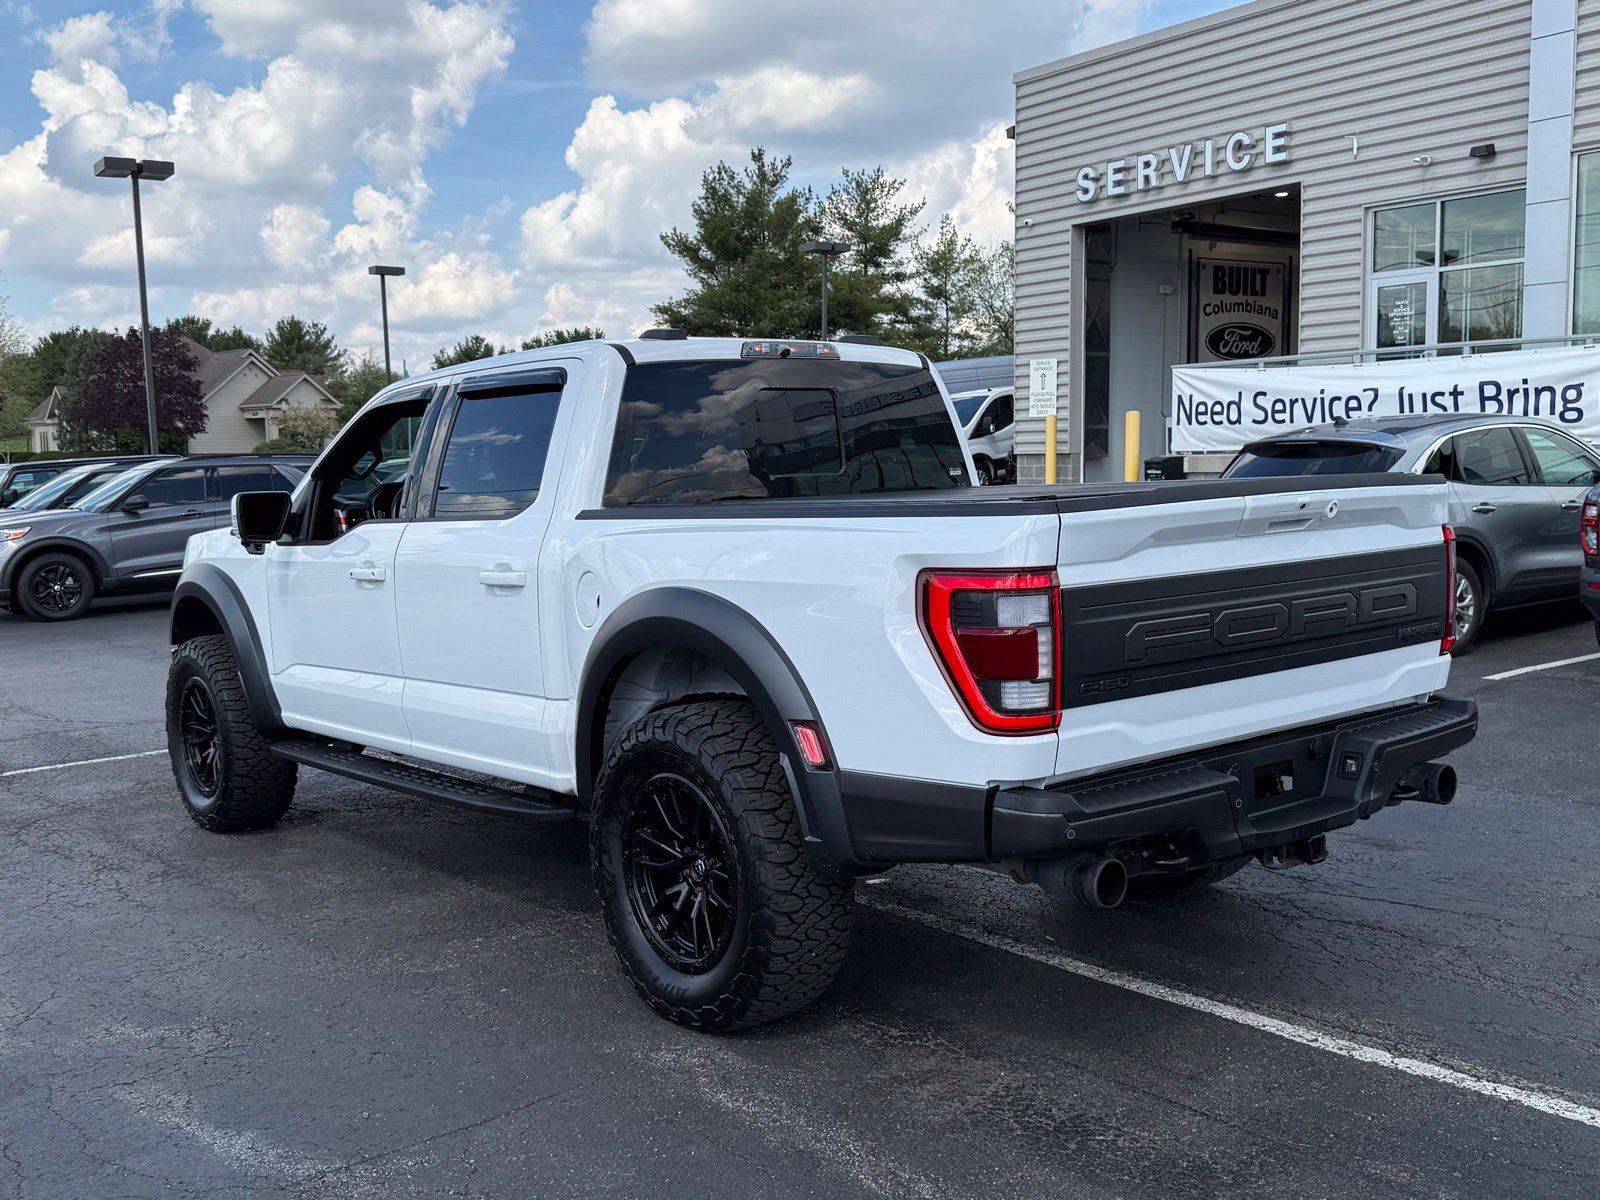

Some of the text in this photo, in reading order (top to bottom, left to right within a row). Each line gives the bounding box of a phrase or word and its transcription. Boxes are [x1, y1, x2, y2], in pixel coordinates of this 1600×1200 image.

[1076, 121, 1290, 203] SERVICE
[1213, 265, 1270, 297] BUILT
[1203, 299, 1279, 320] Columbiana
[1220, 328, 1262, 355] Ford
[1176, 391, 1243, 426] Need
[1251, 388, 1380, 425] Service?
[1478, 378, 1585, 424] Bring
[1123, 583, 1418, 663] FORD
